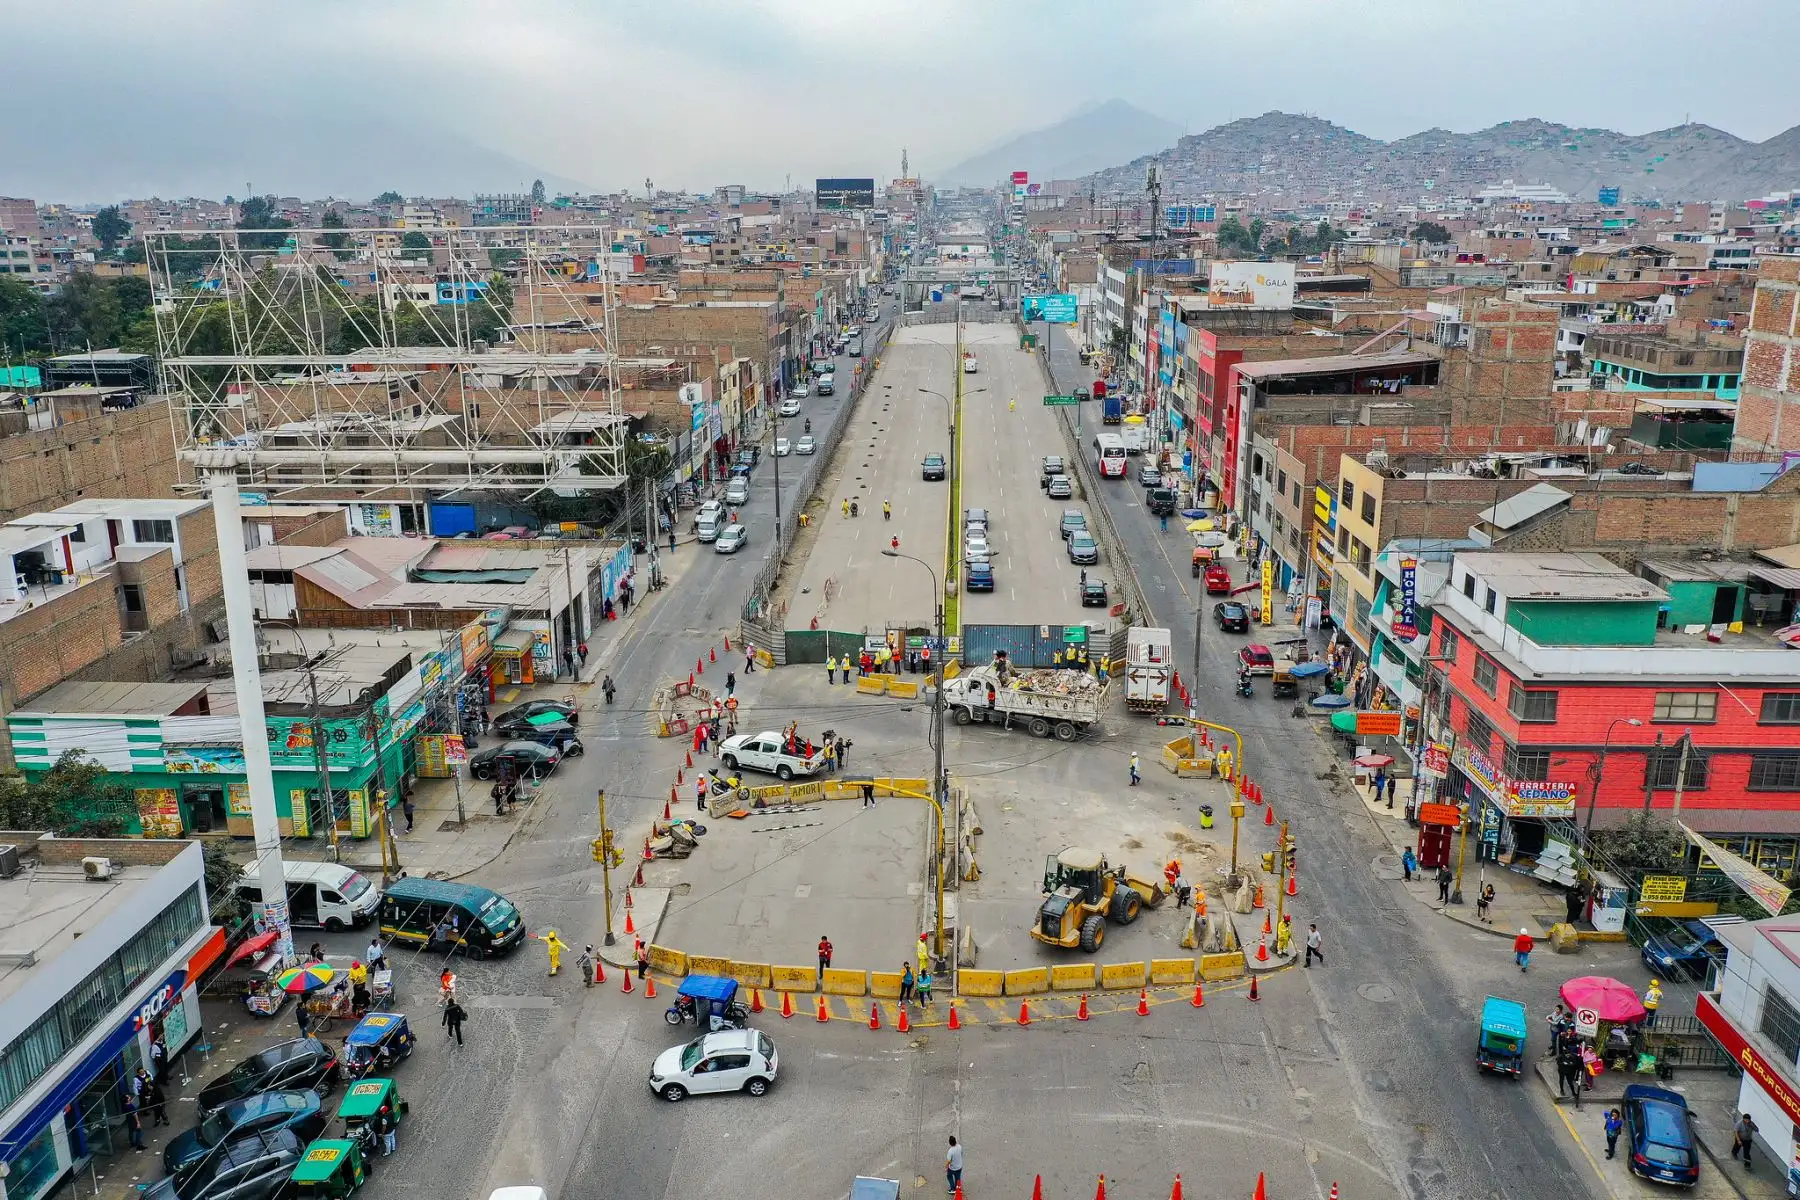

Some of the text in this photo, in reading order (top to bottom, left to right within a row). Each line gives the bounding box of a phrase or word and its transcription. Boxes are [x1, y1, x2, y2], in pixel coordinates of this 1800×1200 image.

[1265, 279, 1288, 287] GALA
[1404, 570, 1415, 623] HOSTAL
[1513, 782, 1576, 790] FERRETERIA
[1518, 789, 1571, 799] SEDANO
[140, 988, 167, 1025] BCP
[1752, 1060, 1776, 1089] CAJA
